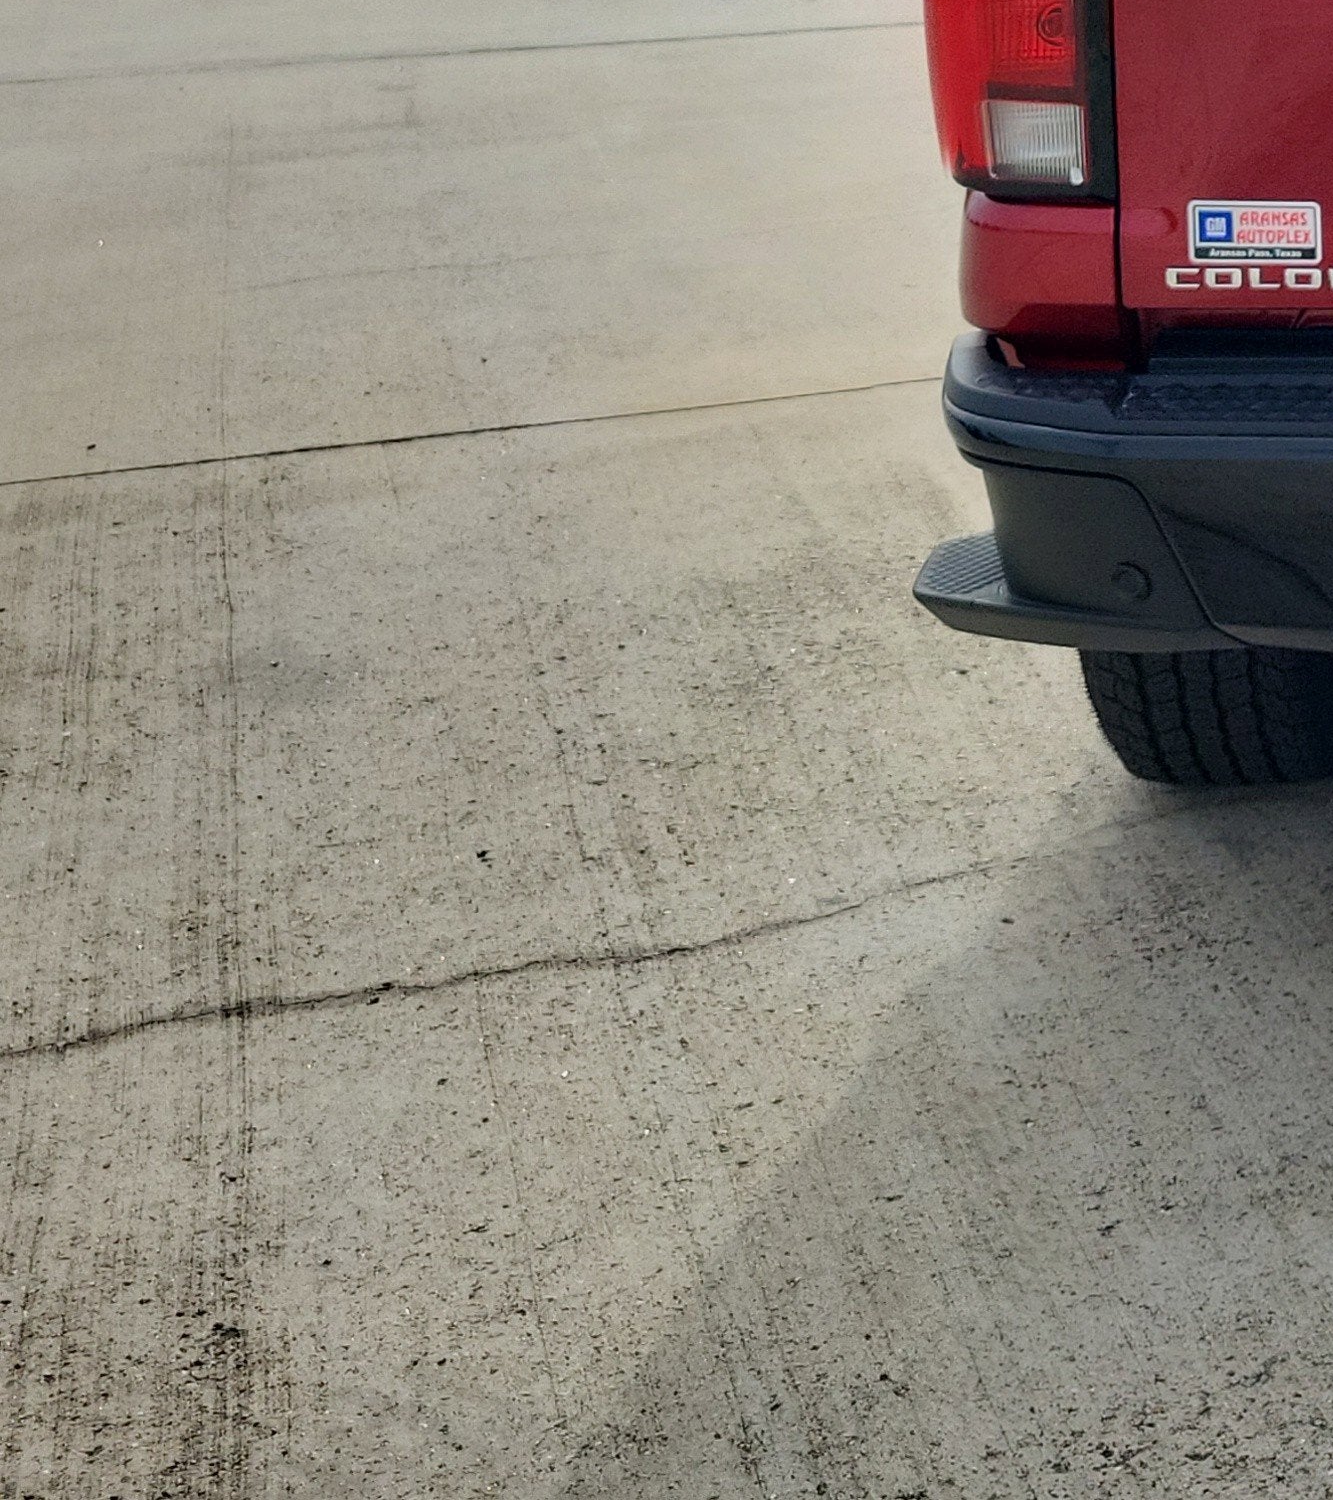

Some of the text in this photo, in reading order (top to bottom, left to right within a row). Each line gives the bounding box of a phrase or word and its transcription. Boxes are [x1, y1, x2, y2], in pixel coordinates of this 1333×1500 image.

[1239, 211, 1308, 227] ARANSAS
[1236, 229, 1312, 245] AUTOPLEX
[1209, 247, 1247, 258] Aransas
[1276, 248, 1303, 258] Texas
